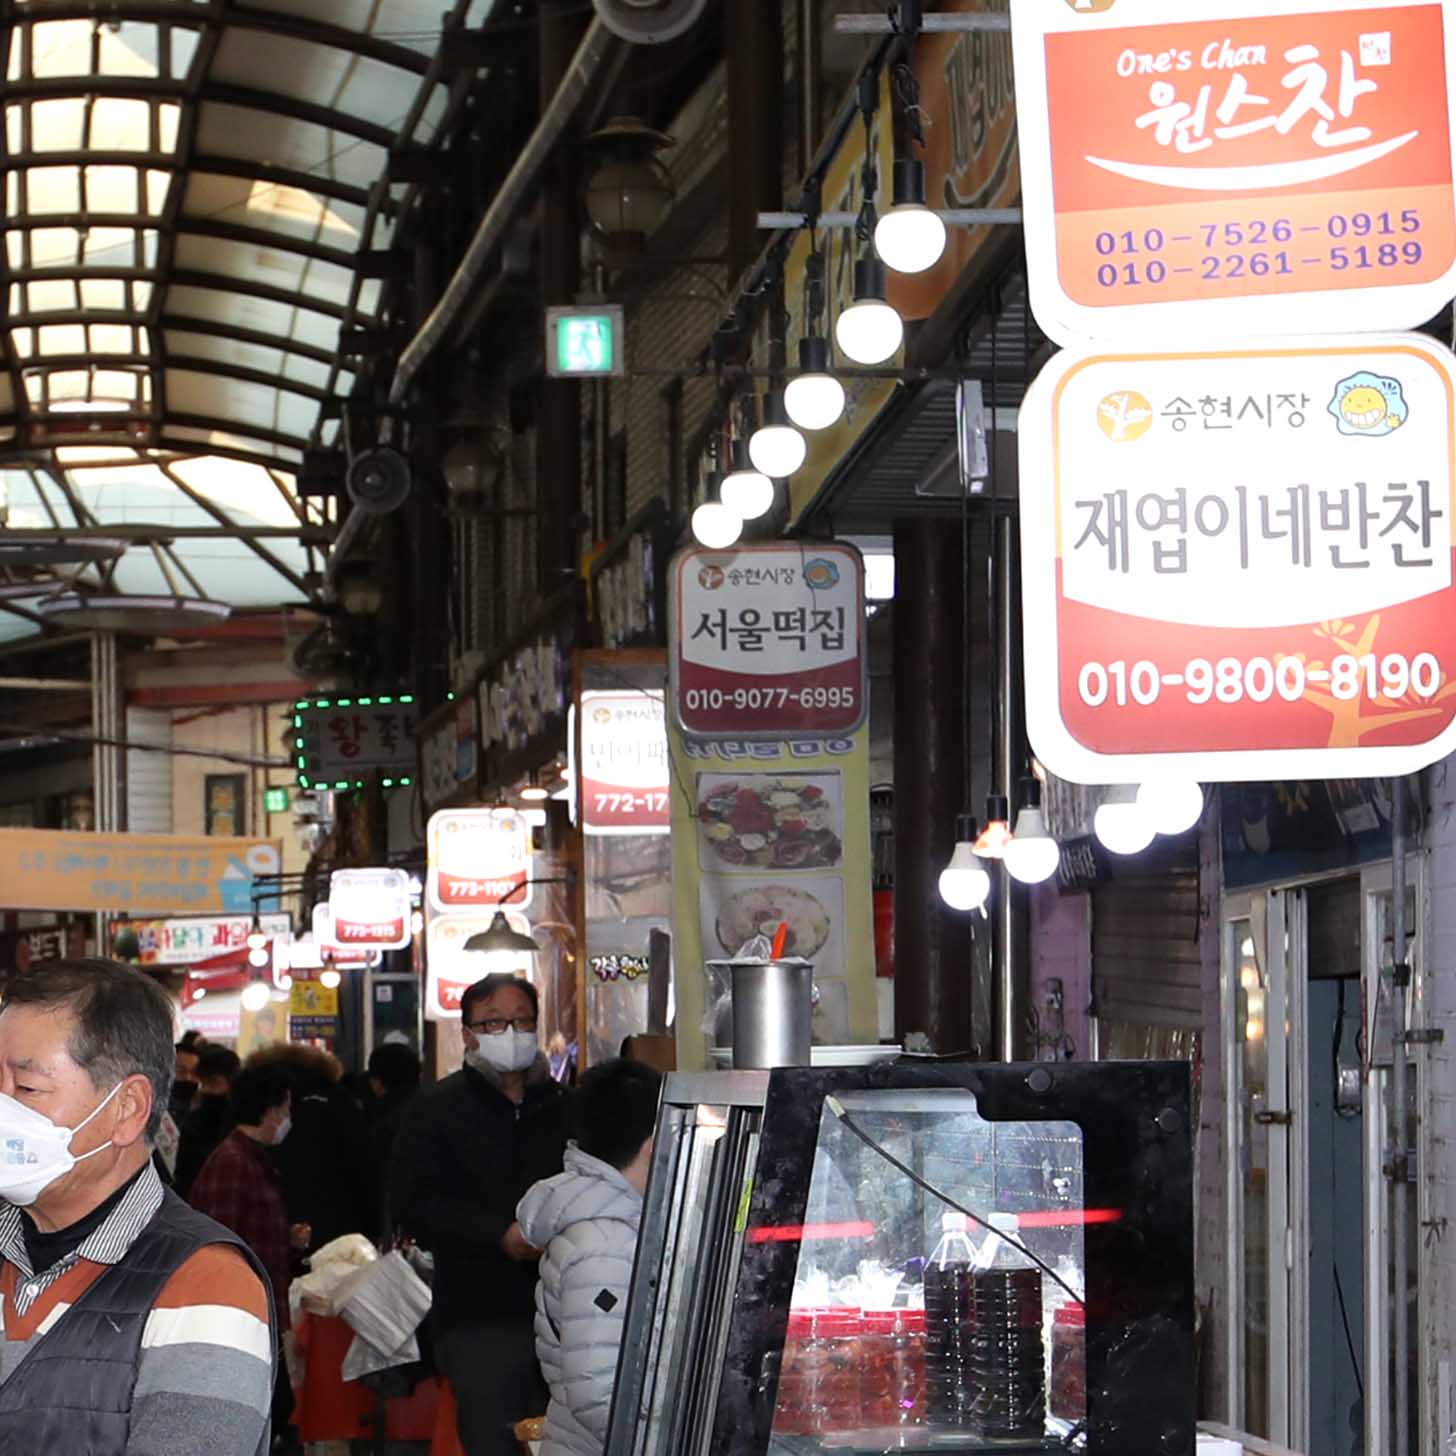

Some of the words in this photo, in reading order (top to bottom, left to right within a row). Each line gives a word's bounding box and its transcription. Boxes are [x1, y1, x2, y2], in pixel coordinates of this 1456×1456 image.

[1117, 49, 1192, 77] One's
[1200, 38, 1266, 69] Chan
[1135, 44, 1377, 153] 원스찬
[1096, 210, 1422, 257] 010-7526-0915
[1097, 242, 1424, 289] 010-2261-5189
[1160, 392, 1311, 433] 송현시장
[1074, 480, 1443, 575] 재엽이네반찬
[727, 567, 795, 585] 송현시장
[691, 607, 845, 651] 서울떡집
[686, 687, 854, 709] 010-9077-6995
[1079, 652, 1441, 707] 010-9800-8190
[594, 793, 669, 813] 772-17
